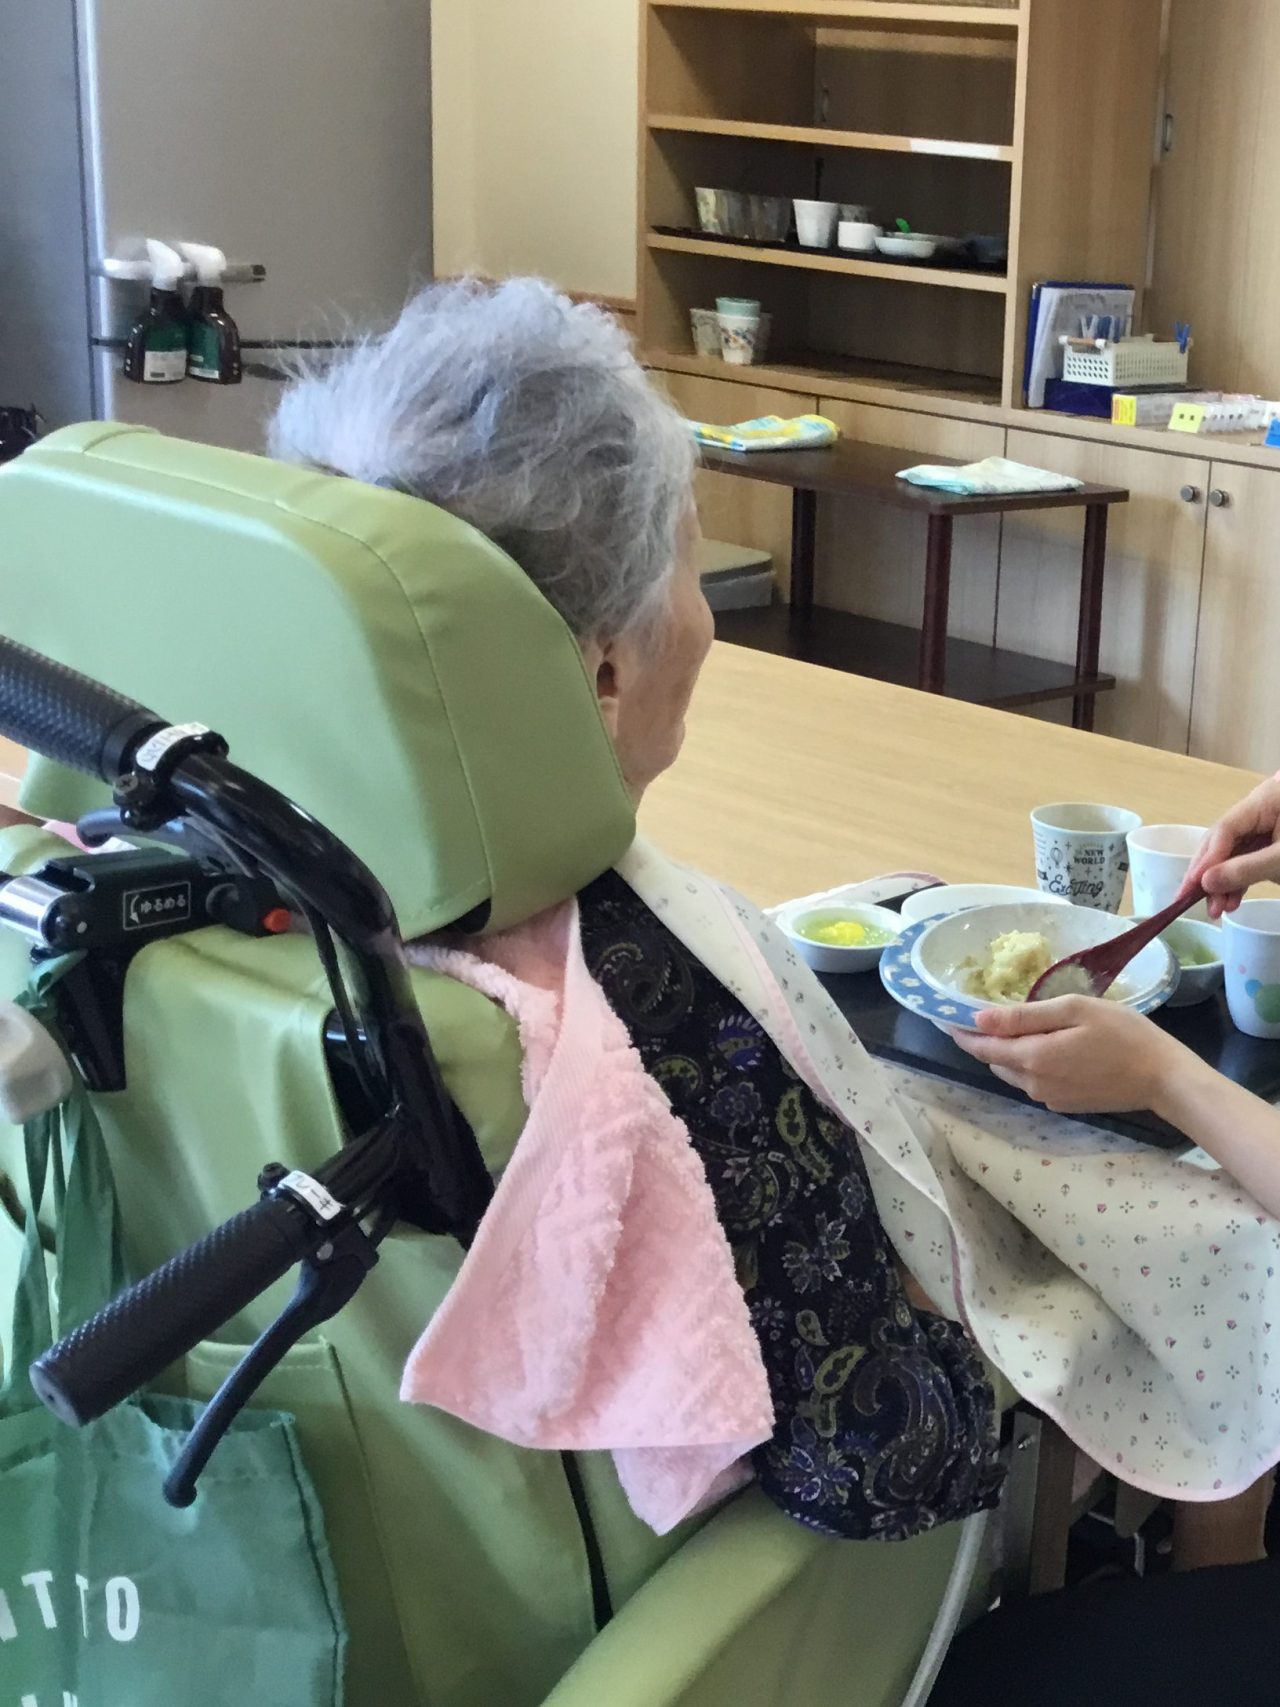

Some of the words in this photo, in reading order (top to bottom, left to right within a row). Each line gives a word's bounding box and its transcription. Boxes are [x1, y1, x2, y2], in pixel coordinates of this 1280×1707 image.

[1073, 856, 1105, 865] WORLD
[140, 893, 187, 914] ゆるめる
